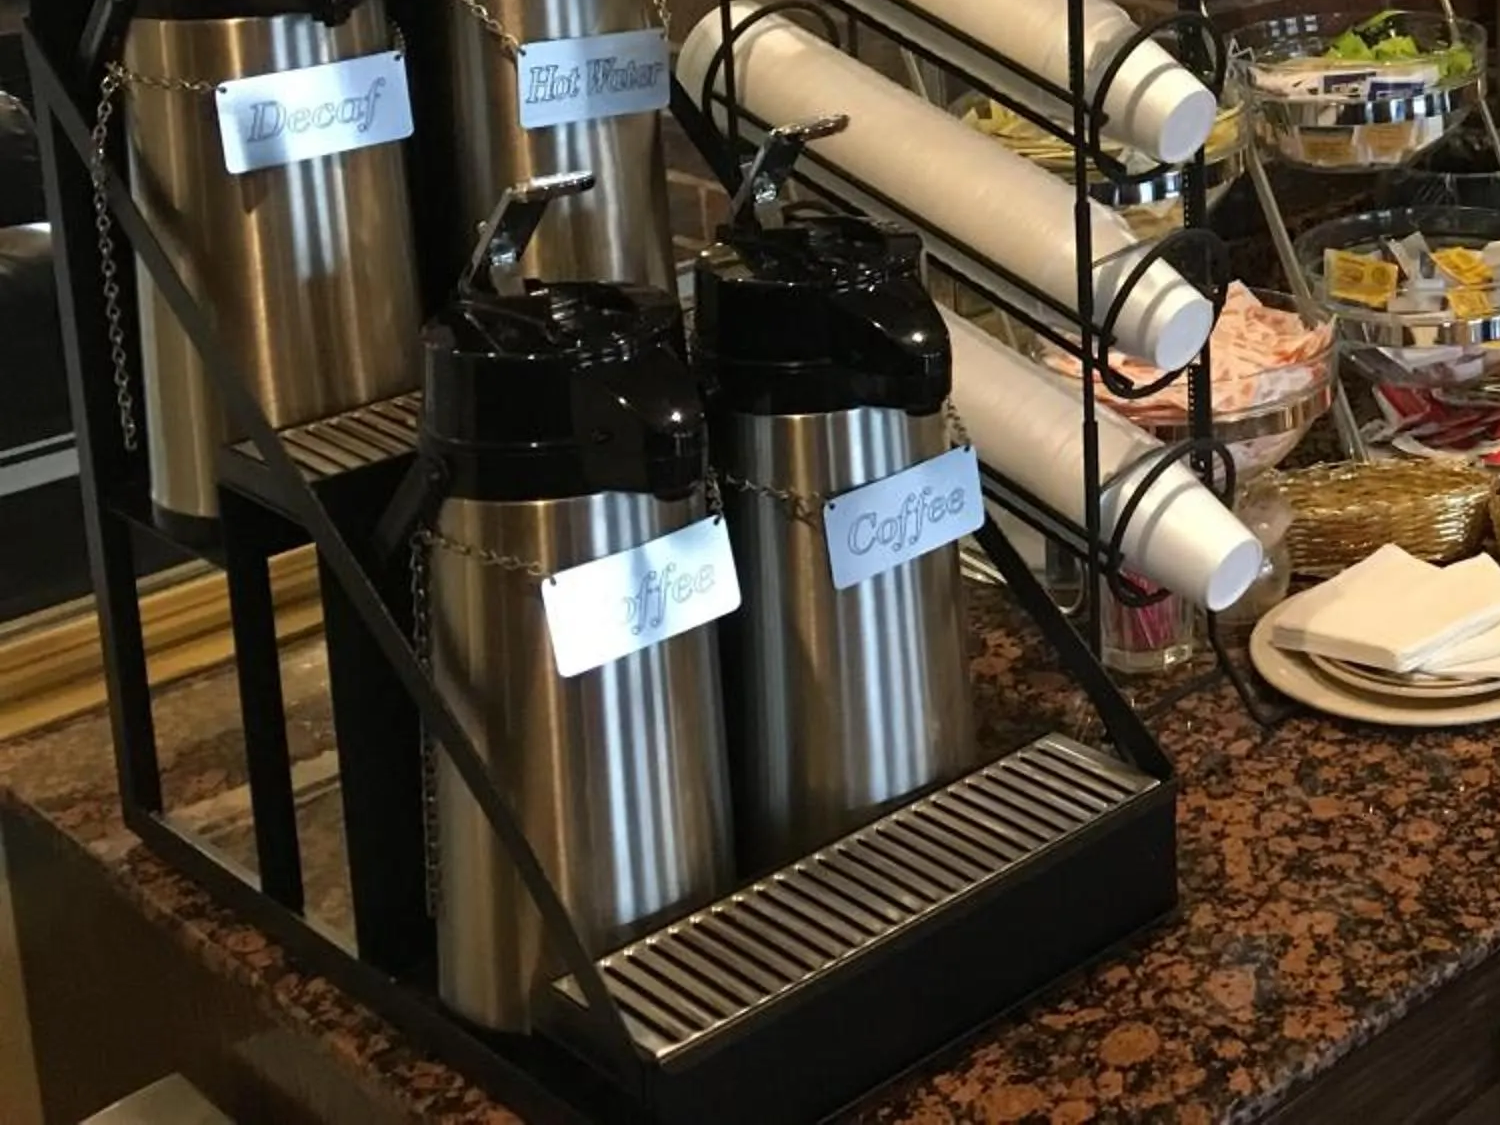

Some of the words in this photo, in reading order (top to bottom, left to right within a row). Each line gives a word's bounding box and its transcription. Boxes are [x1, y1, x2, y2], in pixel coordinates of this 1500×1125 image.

[246, 78, 385, 142] Decaf
[526, 65, 580, 104] Hot
[586, 57, 664, 96] Water
[847, 484, 966, 556] Coffee
[623, 562, 716, 635] offee
